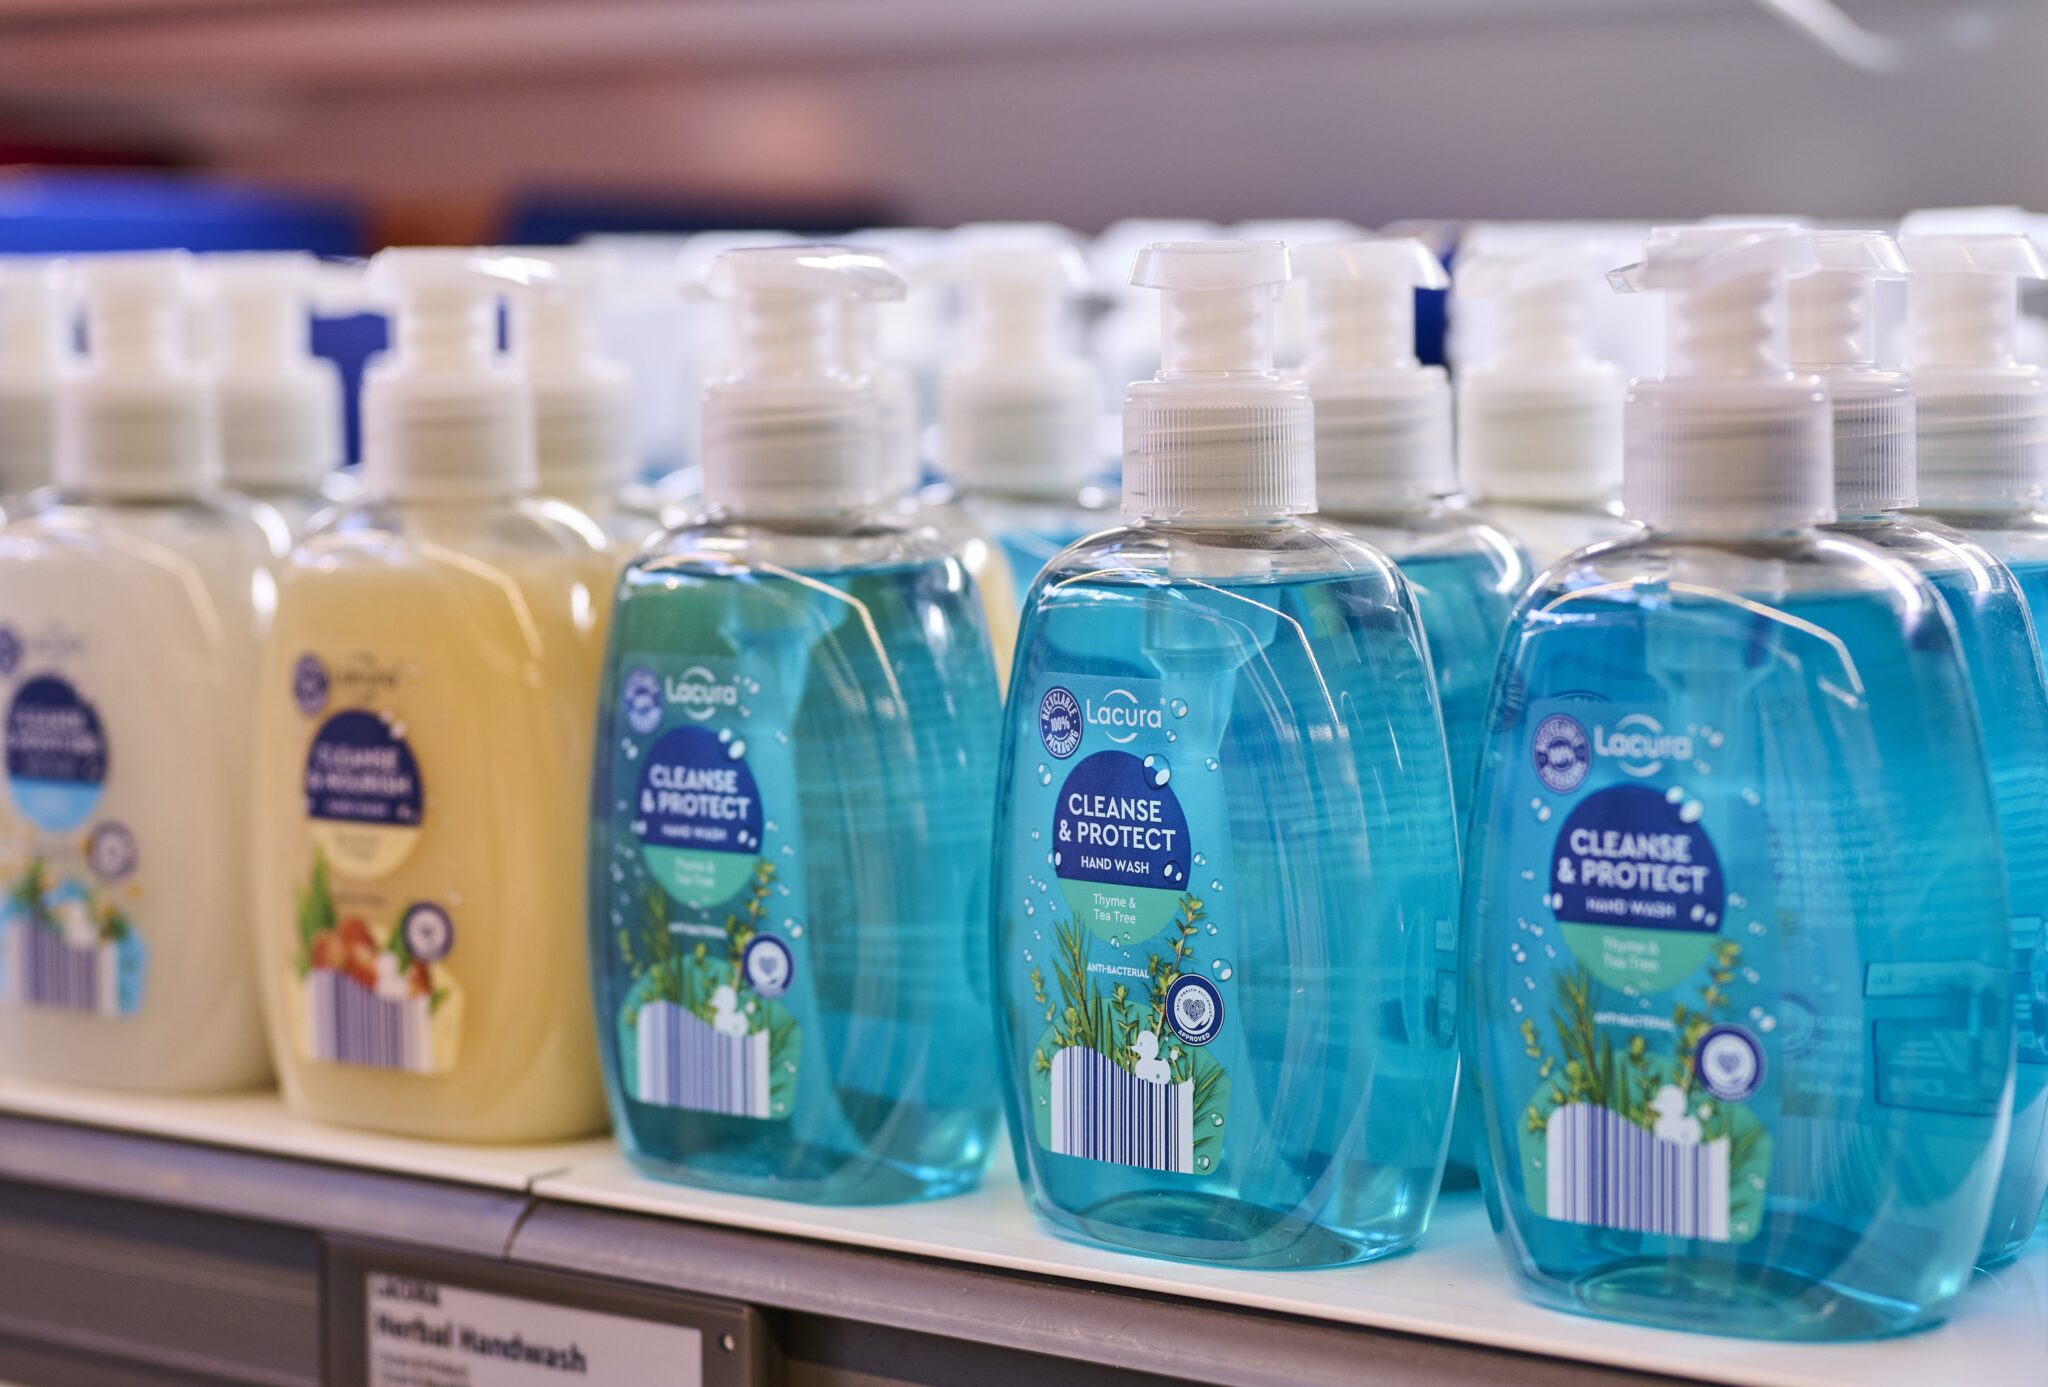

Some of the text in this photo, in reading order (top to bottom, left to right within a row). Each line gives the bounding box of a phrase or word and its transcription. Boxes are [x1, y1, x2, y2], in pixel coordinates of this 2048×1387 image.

[665, 675, 737, 706] Lacura
[1041, 690, 1077, 721] RECYCLABLE
[1050, 716, 1071, 732] 100%
[1086, 698, 1162, 729] Lacura
[1046, 729, 1079, 755] PACKAGING
[1593, 725, 1693, 760] Lacura
[649, 764, 738, 793] CLEANSE
[641, 789, 751, 820] & PROTECT
[1068, 793, 1162, 823] CLEANSE
[1059, 819, 1176, 851] & PROTECT
[1570, 828, 1692, 863] CLEANSE
[1081, 856, 1150, 875] HAND WASH
[1557, 857, 1710, 894] & PROTECT
[1093, 893, 1137, 910] Thyme &
[1094, 908, 1137, 924] Tea Tree
[1087, 962, 1150, 979] ANTI-BACTERIAL
[1177, 1029, 1211, 1042] APPROVED
[377, 1314, 453, 1348] Herbal
[459, 1325, 587, 1374] Handwash
